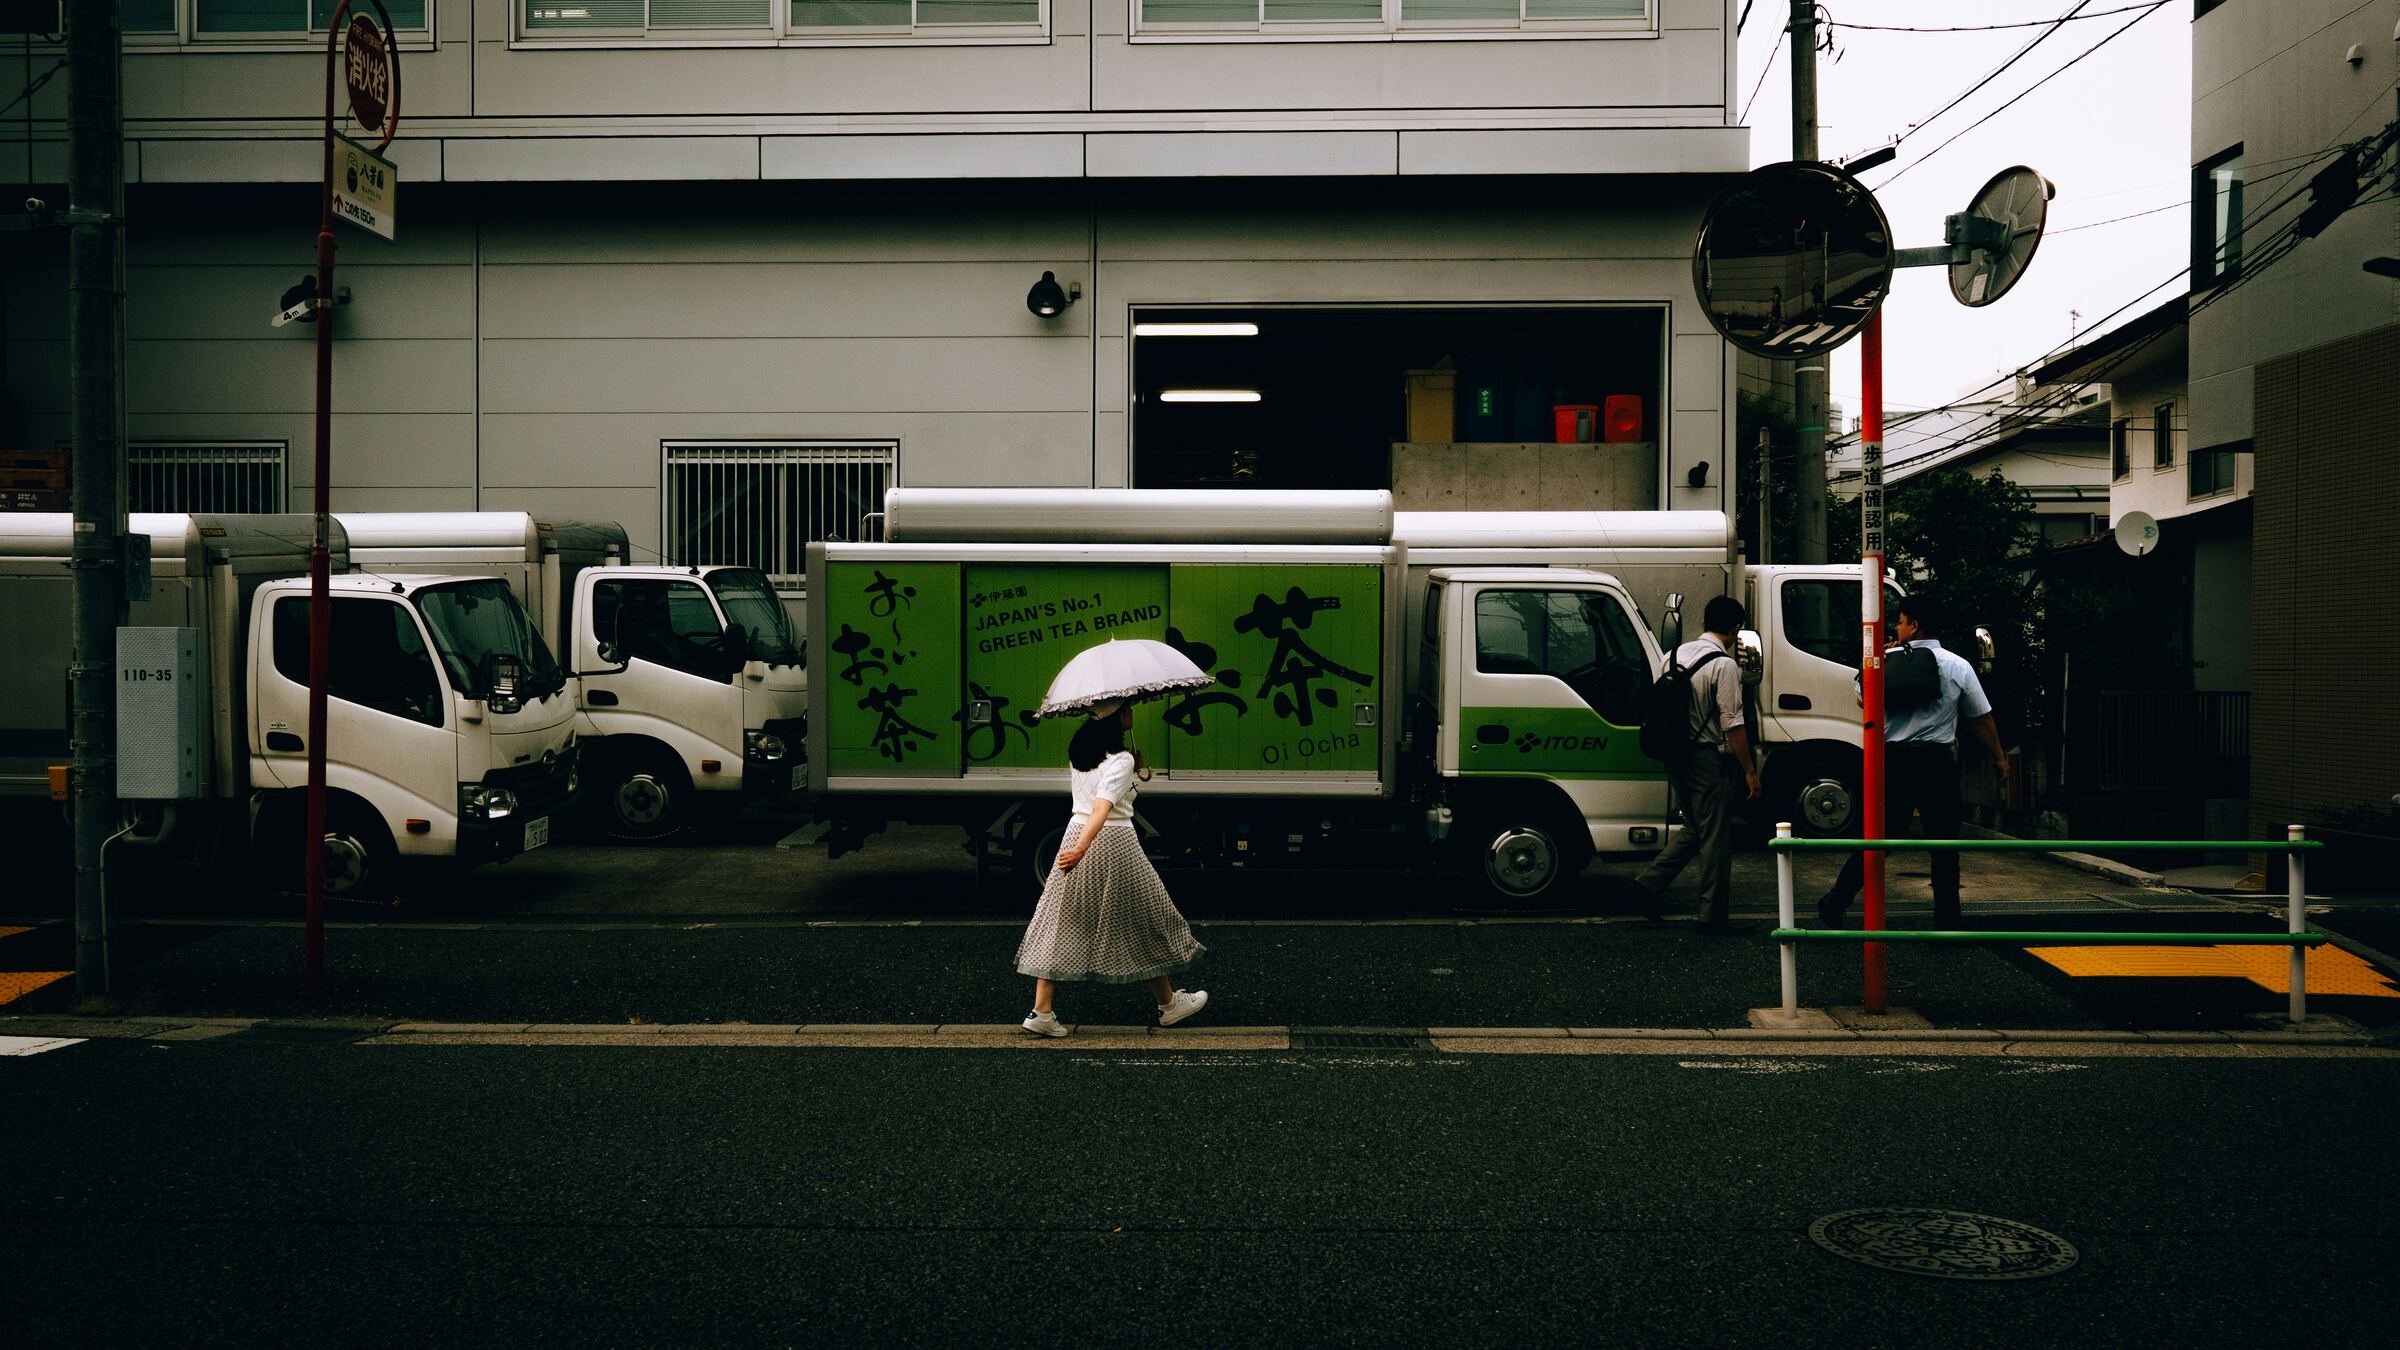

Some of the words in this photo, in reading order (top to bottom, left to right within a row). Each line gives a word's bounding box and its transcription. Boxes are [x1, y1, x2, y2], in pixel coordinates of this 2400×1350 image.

[349, 41, 386, 105] 消火栓
[360, 164, 384, 190] 八芳園
[1863, 445, 1882, 551] 歩道確認用
[974, 602, 1056, 632] JAPAN'S
[1063, 592, 1102, 613] No.1
[989, 585, 1028, 604] 伊藤園
[979, 629, 1044, 654] GREEN
[1048, 620, 1089, 639] TEA
[1093, 604, 1162, 631] BRAND
[124, 669, 172, 681] 110-35
[1263, 742, 1289, 764] Oi
[1298, 732, 1360, 757] Ocha
